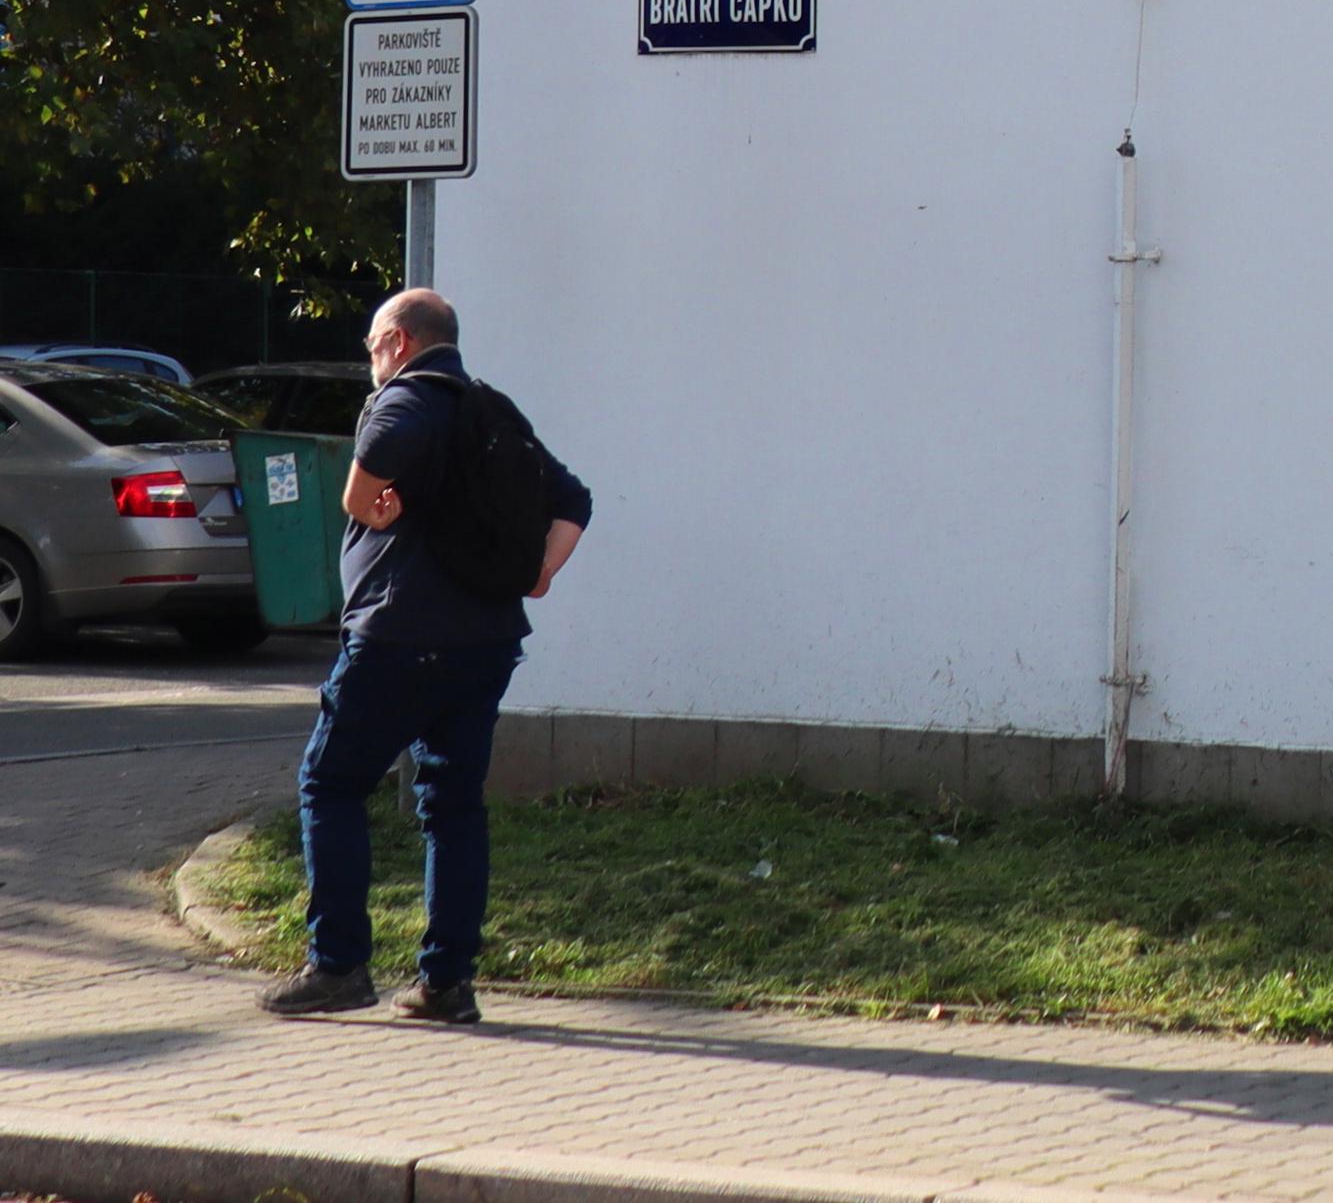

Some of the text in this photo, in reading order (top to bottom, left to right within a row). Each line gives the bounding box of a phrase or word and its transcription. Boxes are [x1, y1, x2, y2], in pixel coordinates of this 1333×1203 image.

[378, 28, 441, 50] PARKOVIŠTĚ
[359, 57, 461, 78] VYHRAZENO POUZE
[365, 81, 452, 105] PRO ZÁKAZNÍKY
[359, 111, 457, 132] MARKETU ALBERT
[358, 139, 457, 155] PO DOBU MAX. 60 MIN.
